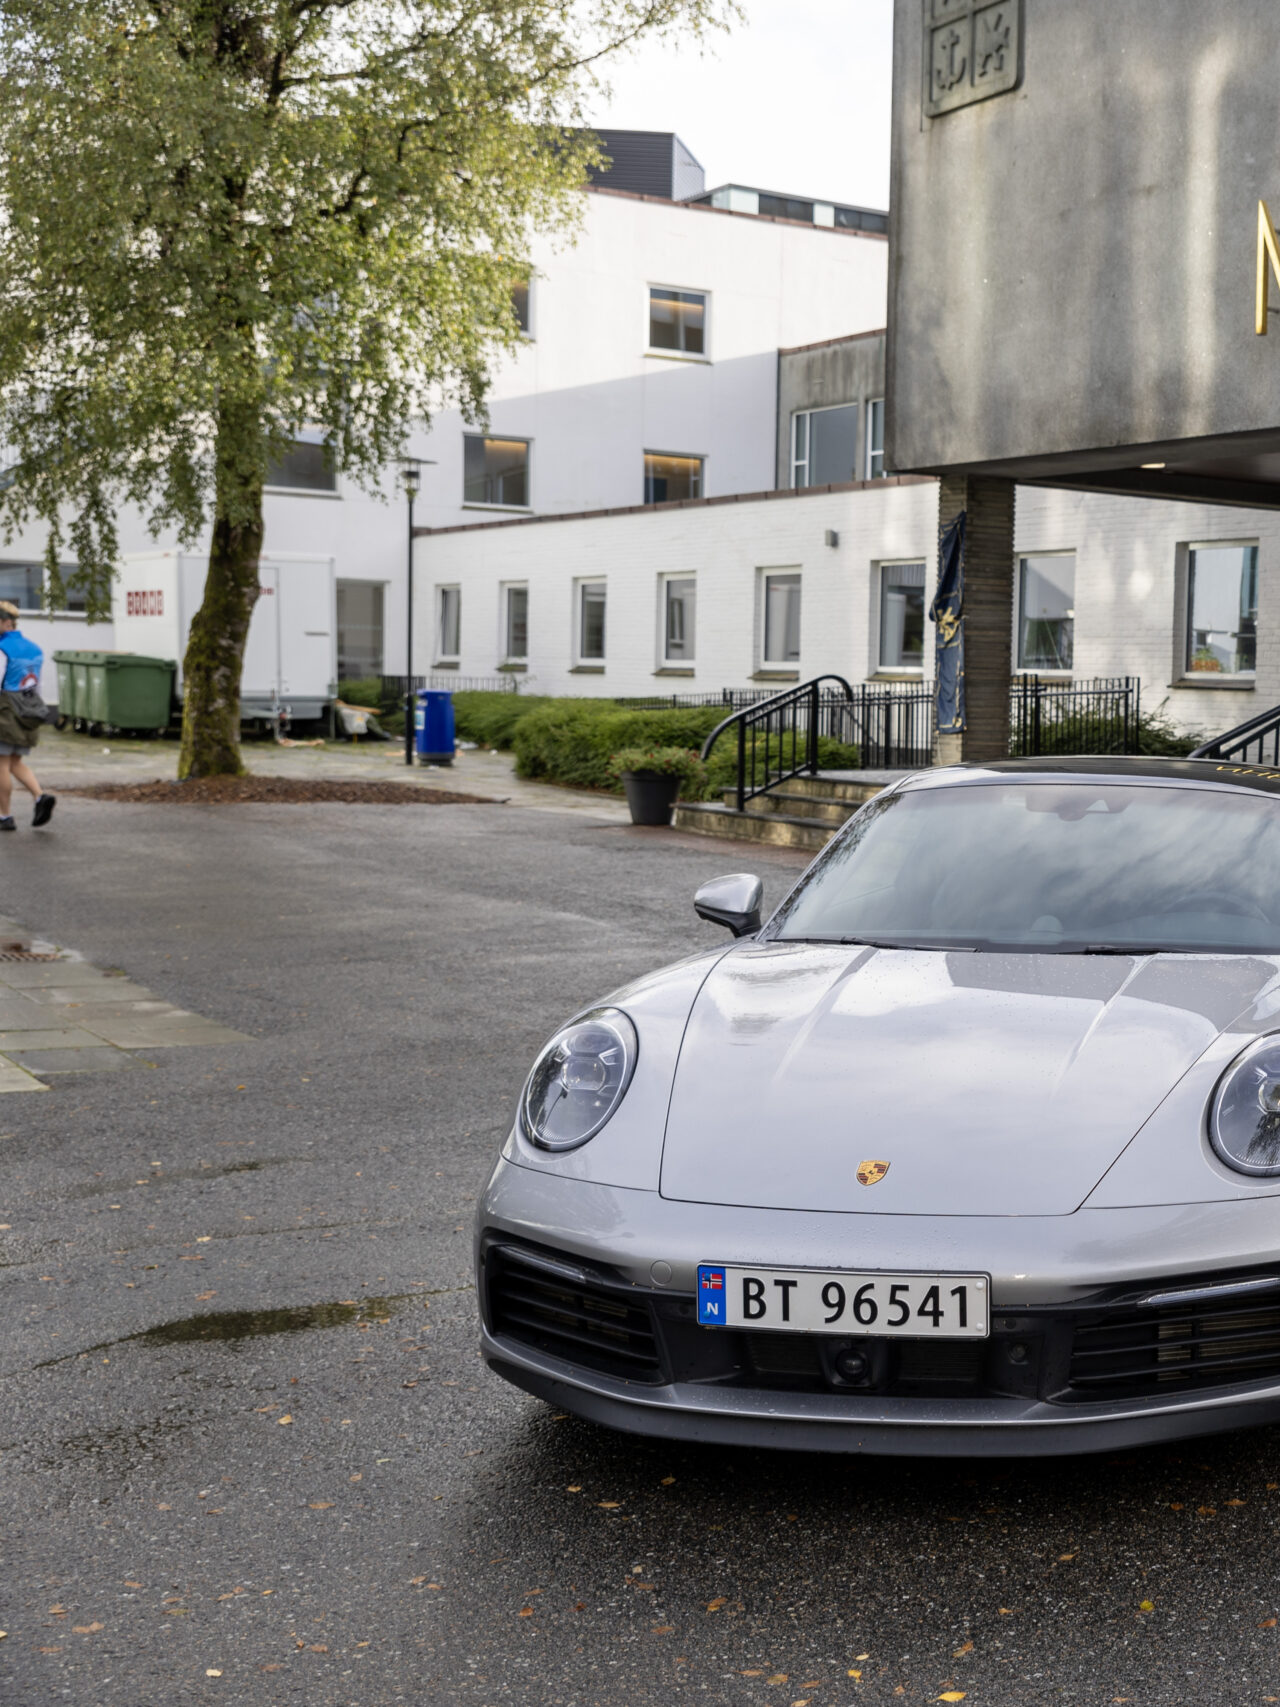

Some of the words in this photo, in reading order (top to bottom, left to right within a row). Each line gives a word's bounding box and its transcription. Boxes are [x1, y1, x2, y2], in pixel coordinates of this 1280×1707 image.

[706, 1302, 719, 1316] N
[742, 1277, 798, 1323] BT
[821, 1281, 968, 1328] 96541
